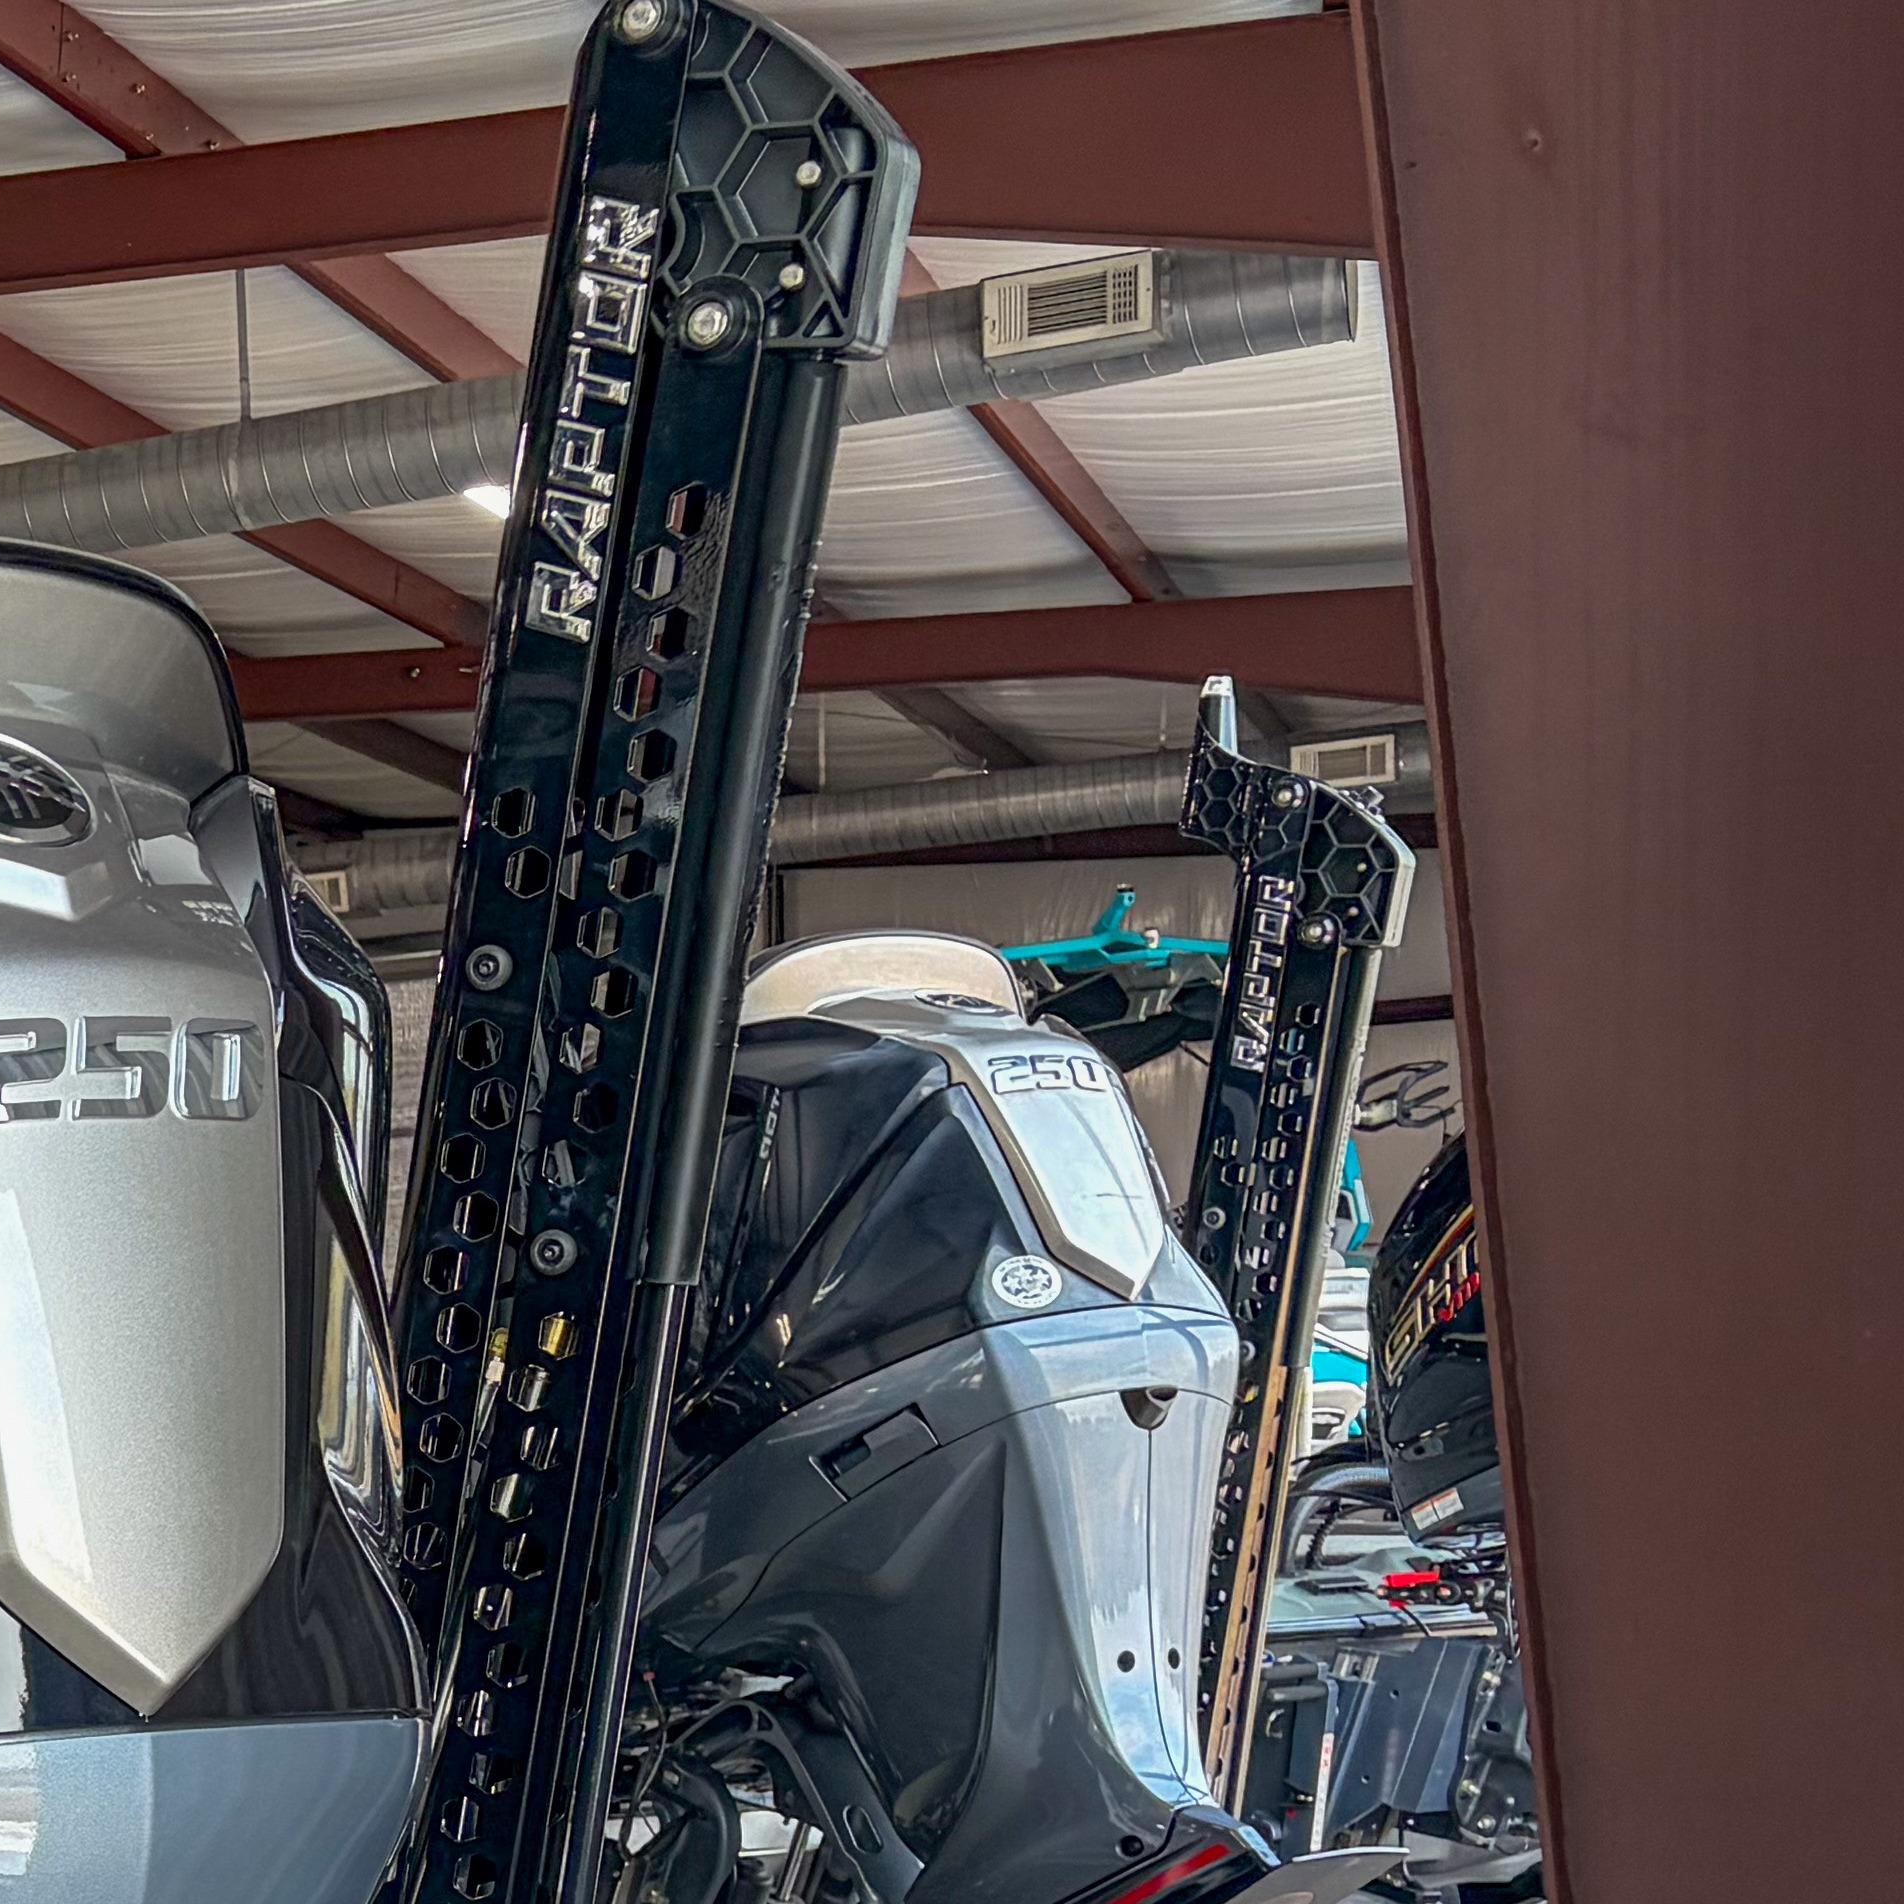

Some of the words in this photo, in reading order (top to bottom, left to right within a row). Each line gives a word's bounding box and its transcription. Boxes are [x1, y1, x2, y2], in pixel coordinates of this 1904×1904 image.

[524, 196, 658, 642] RAPTOR
[1231, 875, 1294, 1073] RAPTOR
[987, 1055, 1108, 1094] 250
